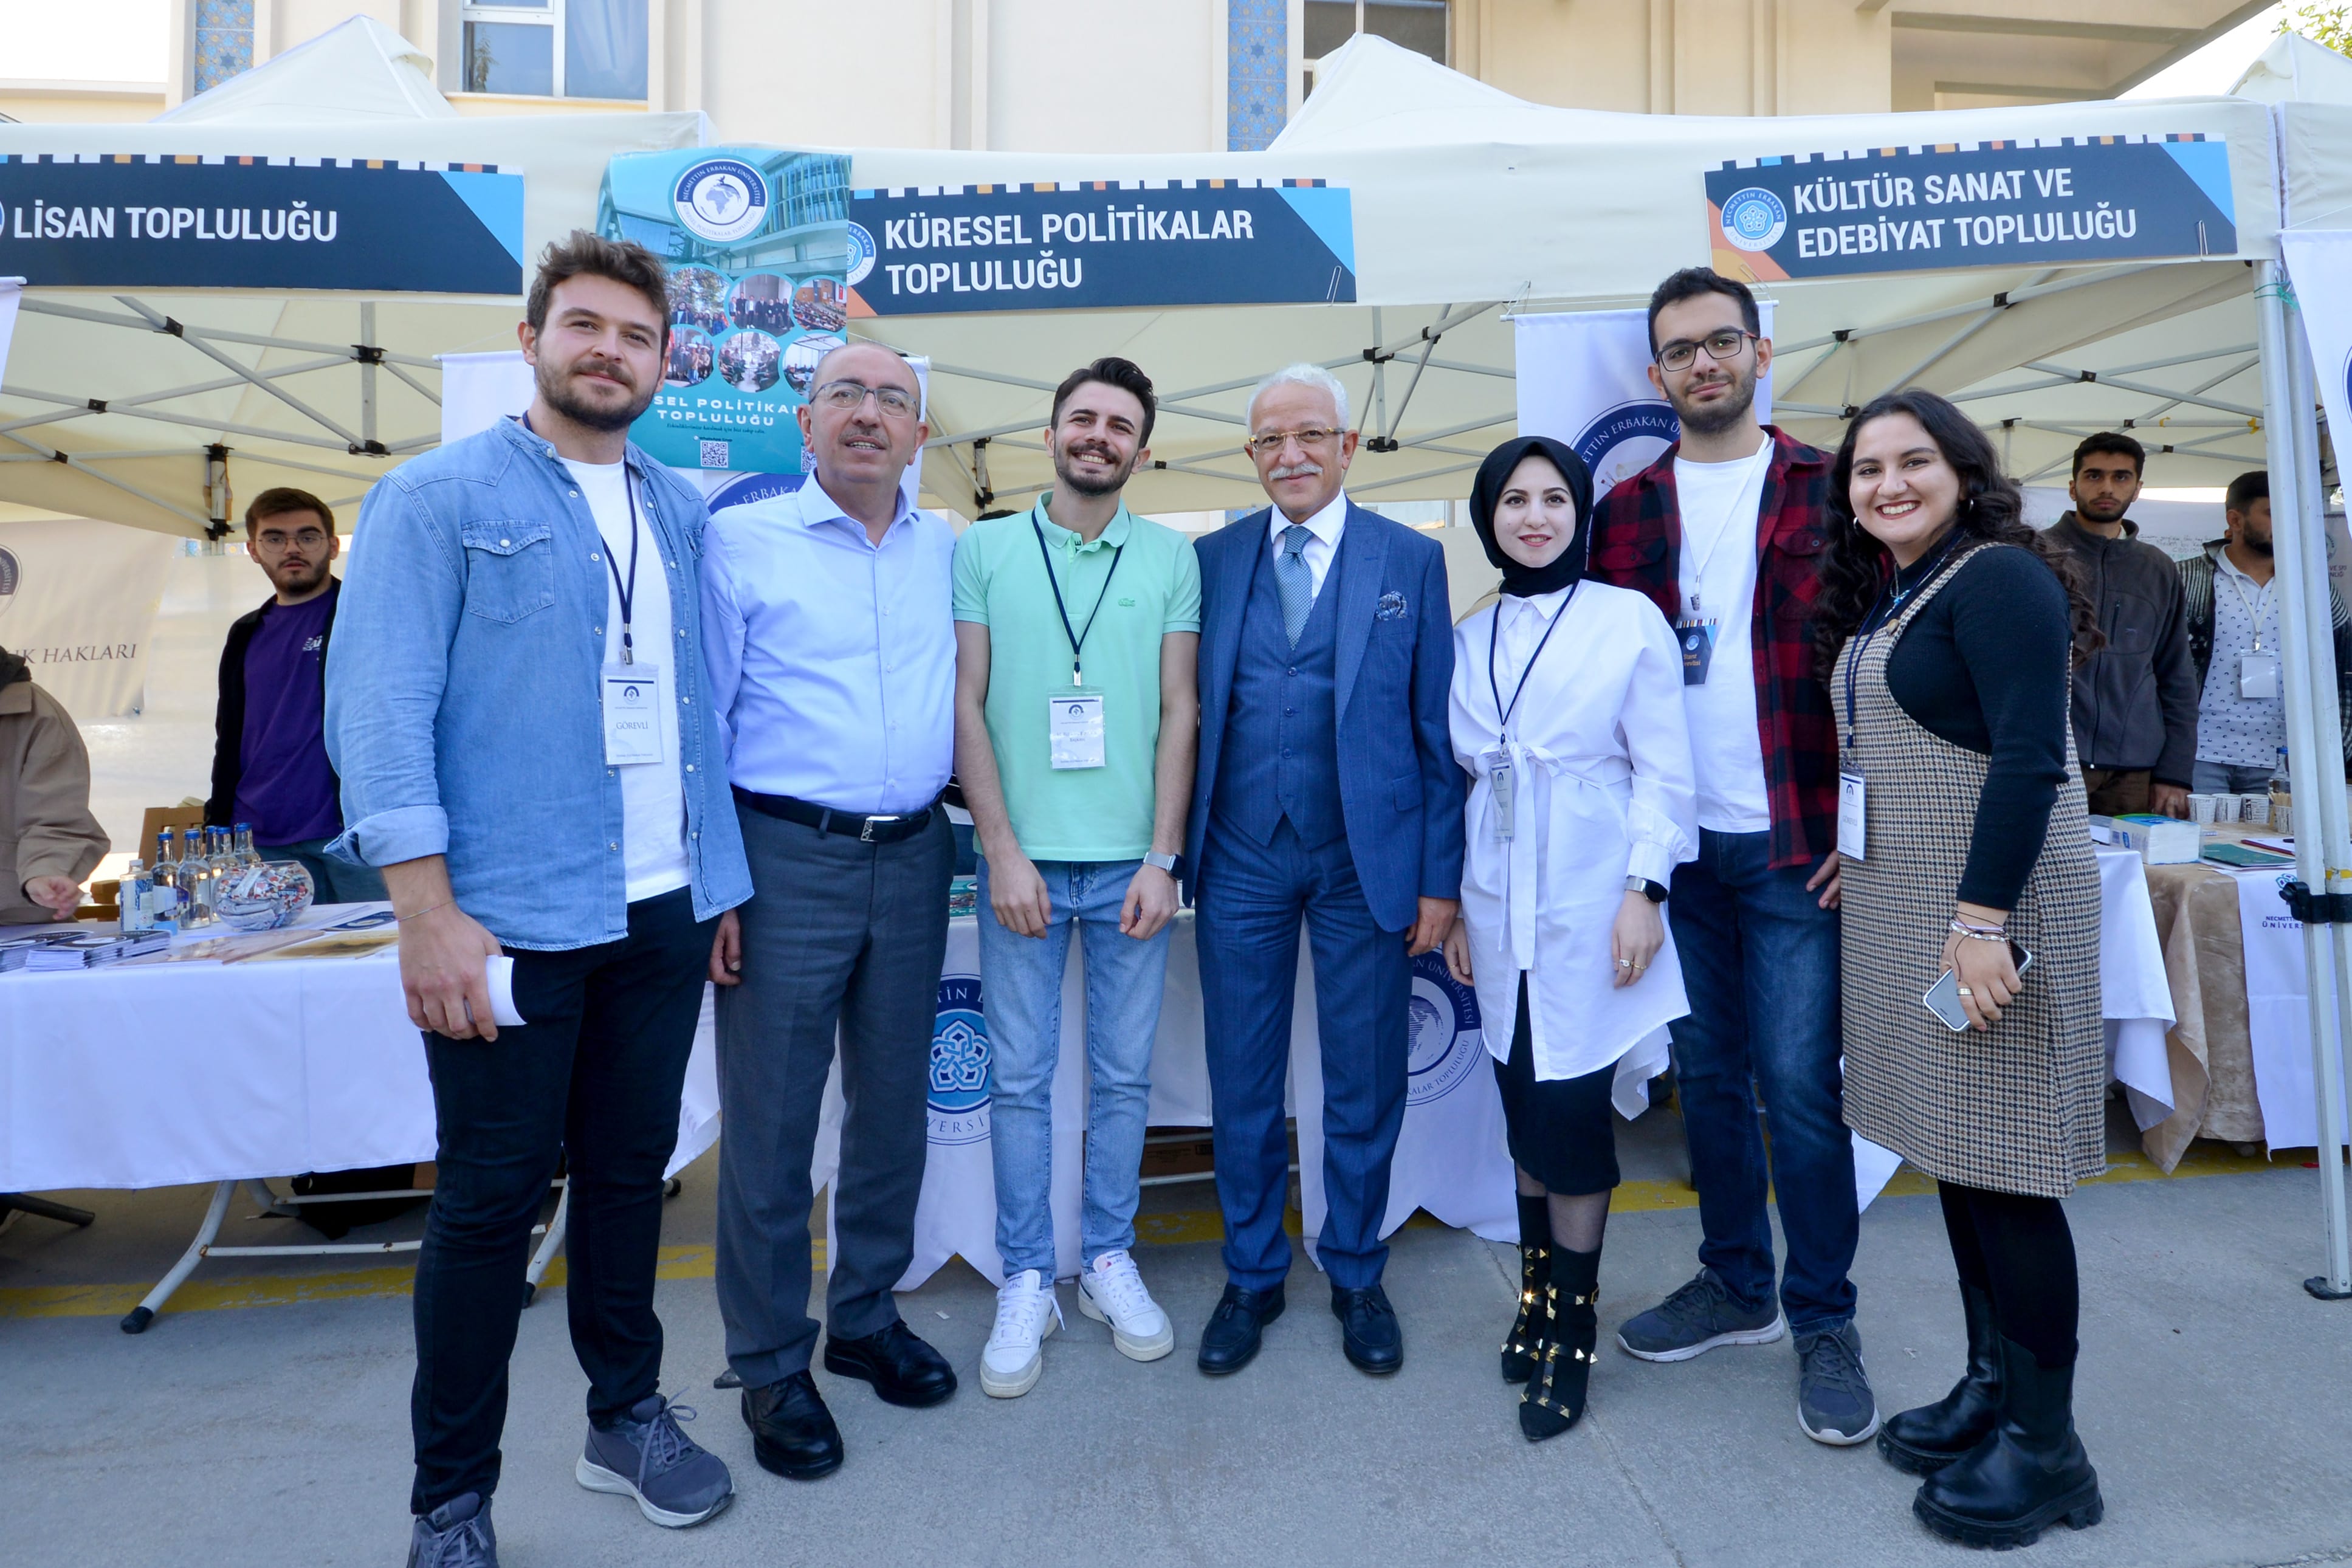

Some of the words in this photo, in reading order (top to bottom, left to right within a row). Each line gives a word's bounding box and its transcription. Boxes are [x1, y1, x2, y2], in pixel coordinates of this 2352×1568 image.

[1794, 173, 1916, 215] KÜLTÜR
[1924, 170, 2026, 203] SANAT
[2032, 168, 2073, 197] VE
[14, 199, 114, 238] LİSAN
[126, 201, 337, 242] TOPLULUĞU
[885, 213, 1032, 250] KÜRESEL
[1042, 204, 1253, 243] POLİTİKALAR
[1798, 219, 1945, 258] EDEBİYAT
[1953, 202, 2136, 246] TOPLULUĞU
[885, 251, 1082, 294] TOPLULUĞU
[657, 410, 774, 426] TOPLULUĞU
[697, 399, 797, 414] POLİTİKAL
[1581, 430, 1610, 464] ETTİN
[1611, 416, 1668, 435] ERBAKAN
[743, 486, 797, 504] ERBAKA
[43, 644, 137, 664] HAKLARI
[616, 720, 648, 729] GÖREVLİ
